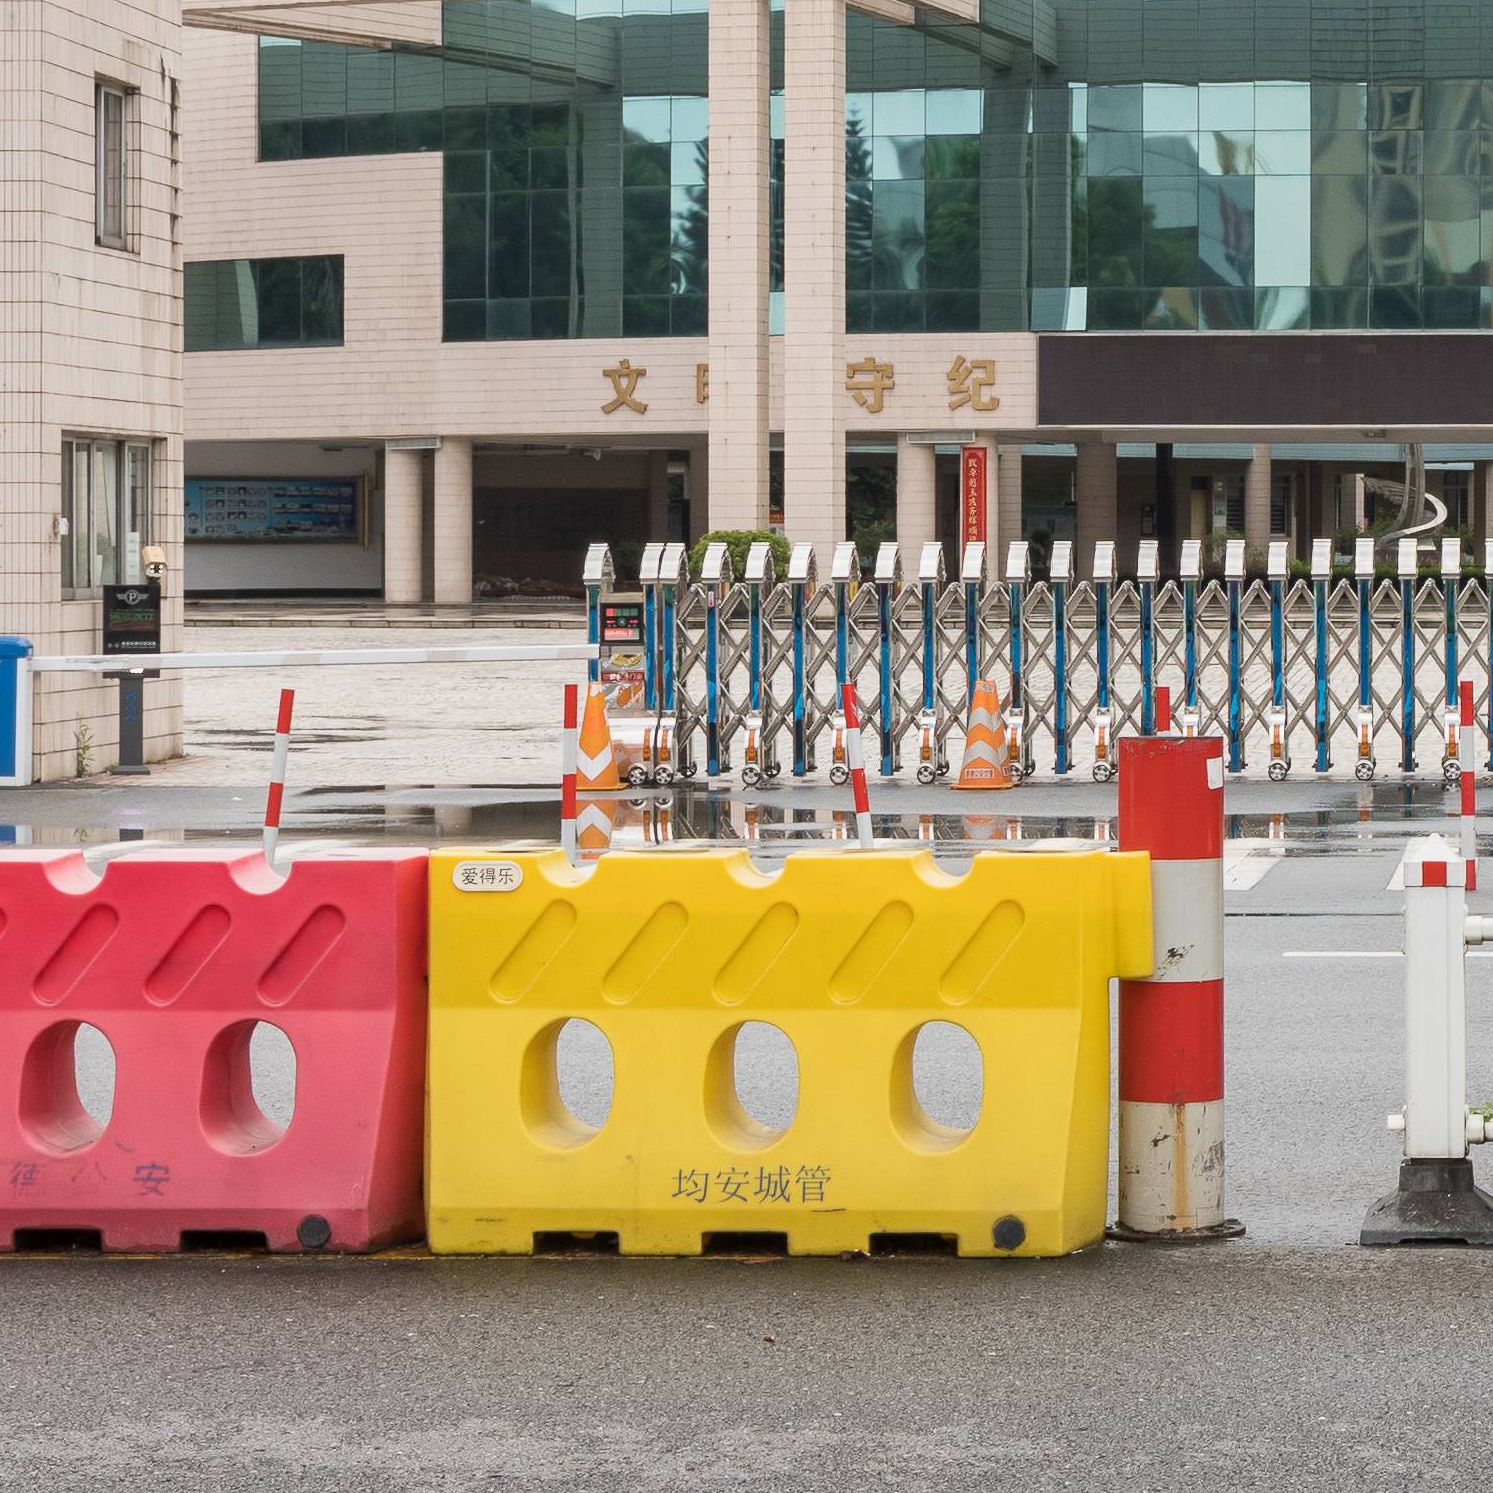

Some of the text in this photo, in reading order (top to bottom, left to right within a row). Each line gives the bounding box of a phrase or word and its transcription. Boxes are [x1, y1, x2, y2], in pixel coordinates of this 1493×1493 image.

[461, 867, 514, 885] 爱得乐
[671, 1165, 832, 1204] 均安城管
